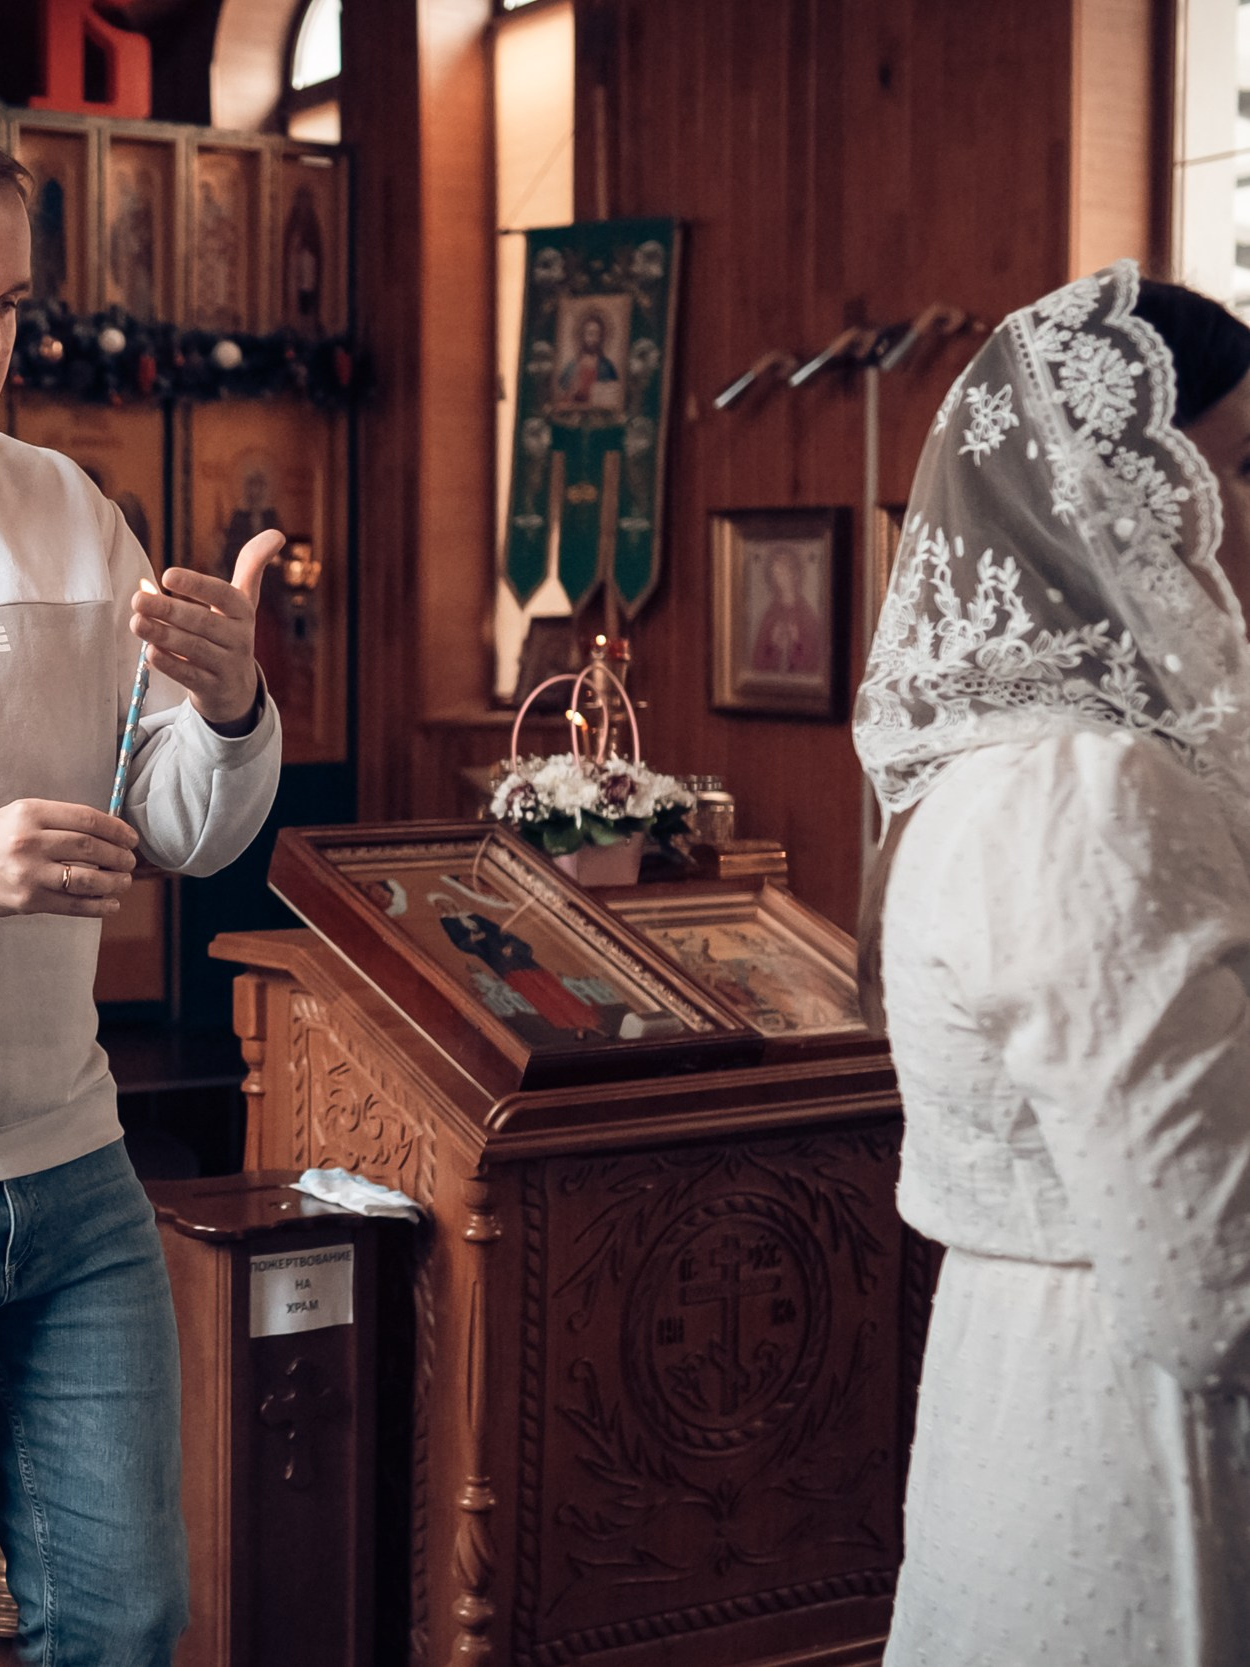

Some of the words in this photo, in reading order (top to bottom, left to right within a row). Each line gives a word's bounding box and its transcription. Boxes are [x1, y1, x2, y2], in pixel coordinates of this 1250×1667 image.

[250, 1250, 351, 1272] ПОЖЕРТВОВАНИЕ
[295, 1278, 312, 1290] НА
[286, 1299, 319, 1314] ХРАМ
